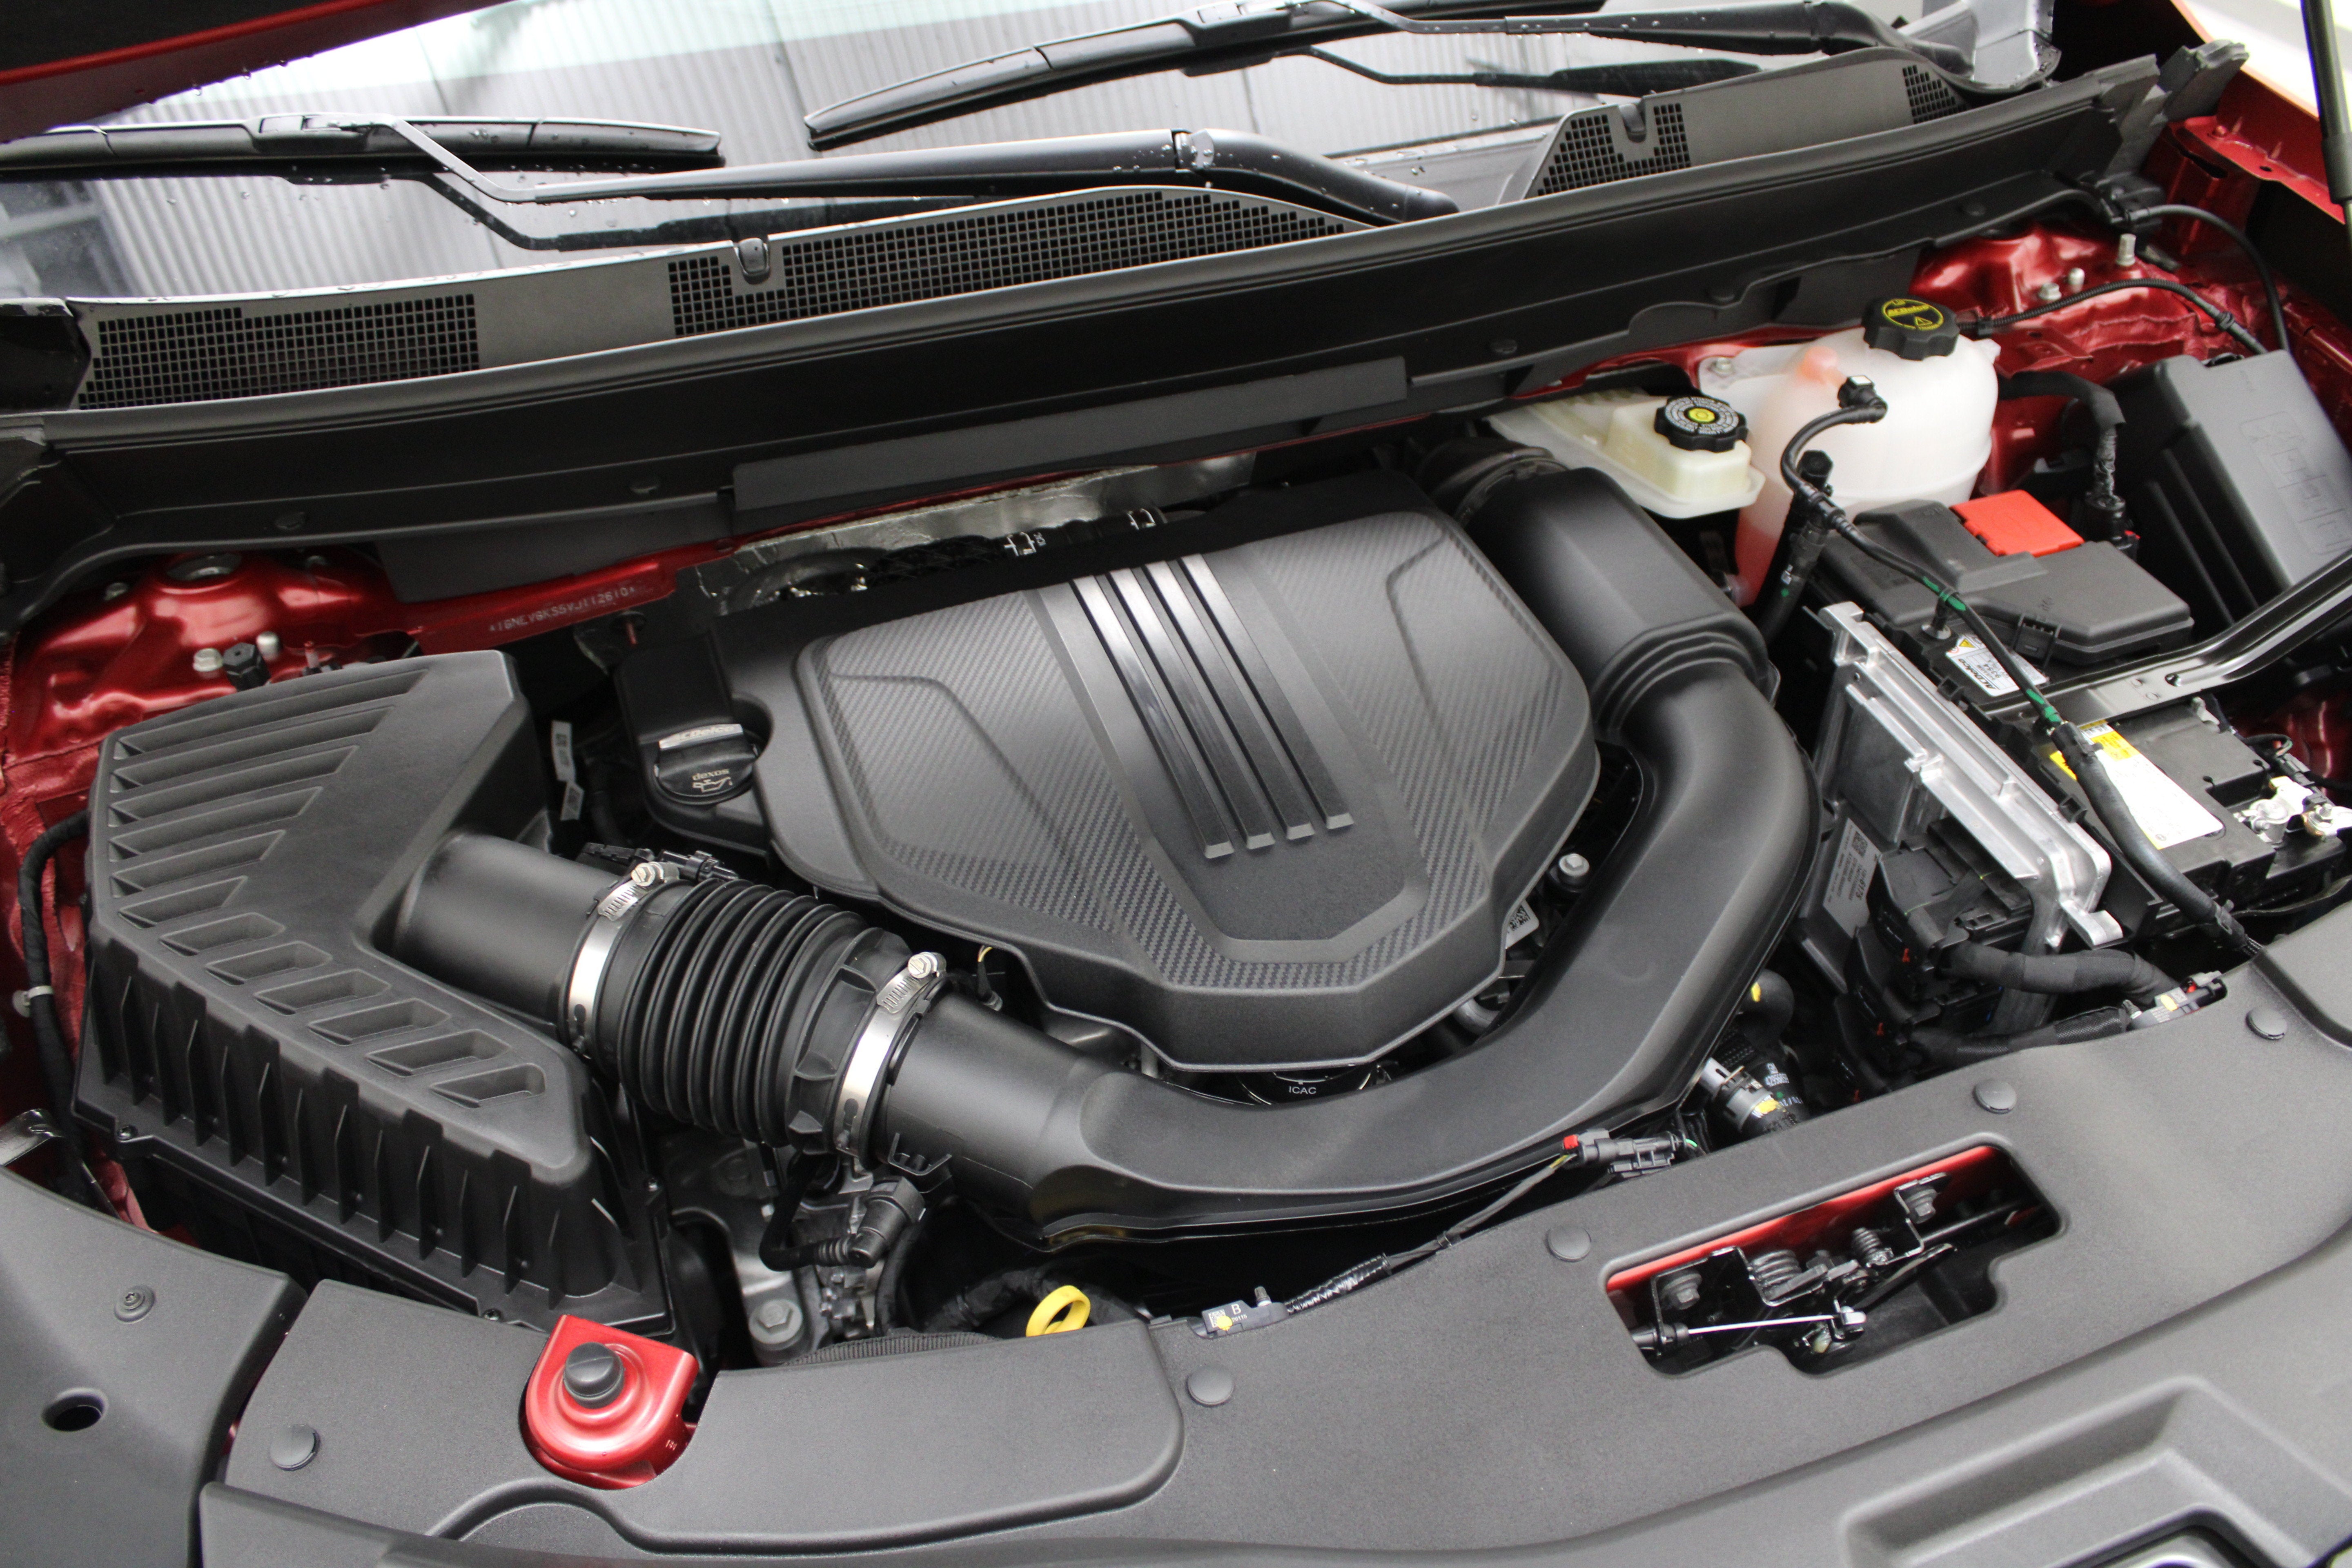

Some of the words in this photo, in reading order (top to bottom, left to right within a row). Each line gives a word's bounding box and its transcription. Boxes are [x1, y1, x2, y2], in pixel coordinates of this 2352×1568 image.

[1958, 658, 1998, 690] ACDelco
[692, 768, 730, 781] dexos
[1289, 1085, 1317, 1095] ICAC
[1231, 1303, 1241, 1315] B
